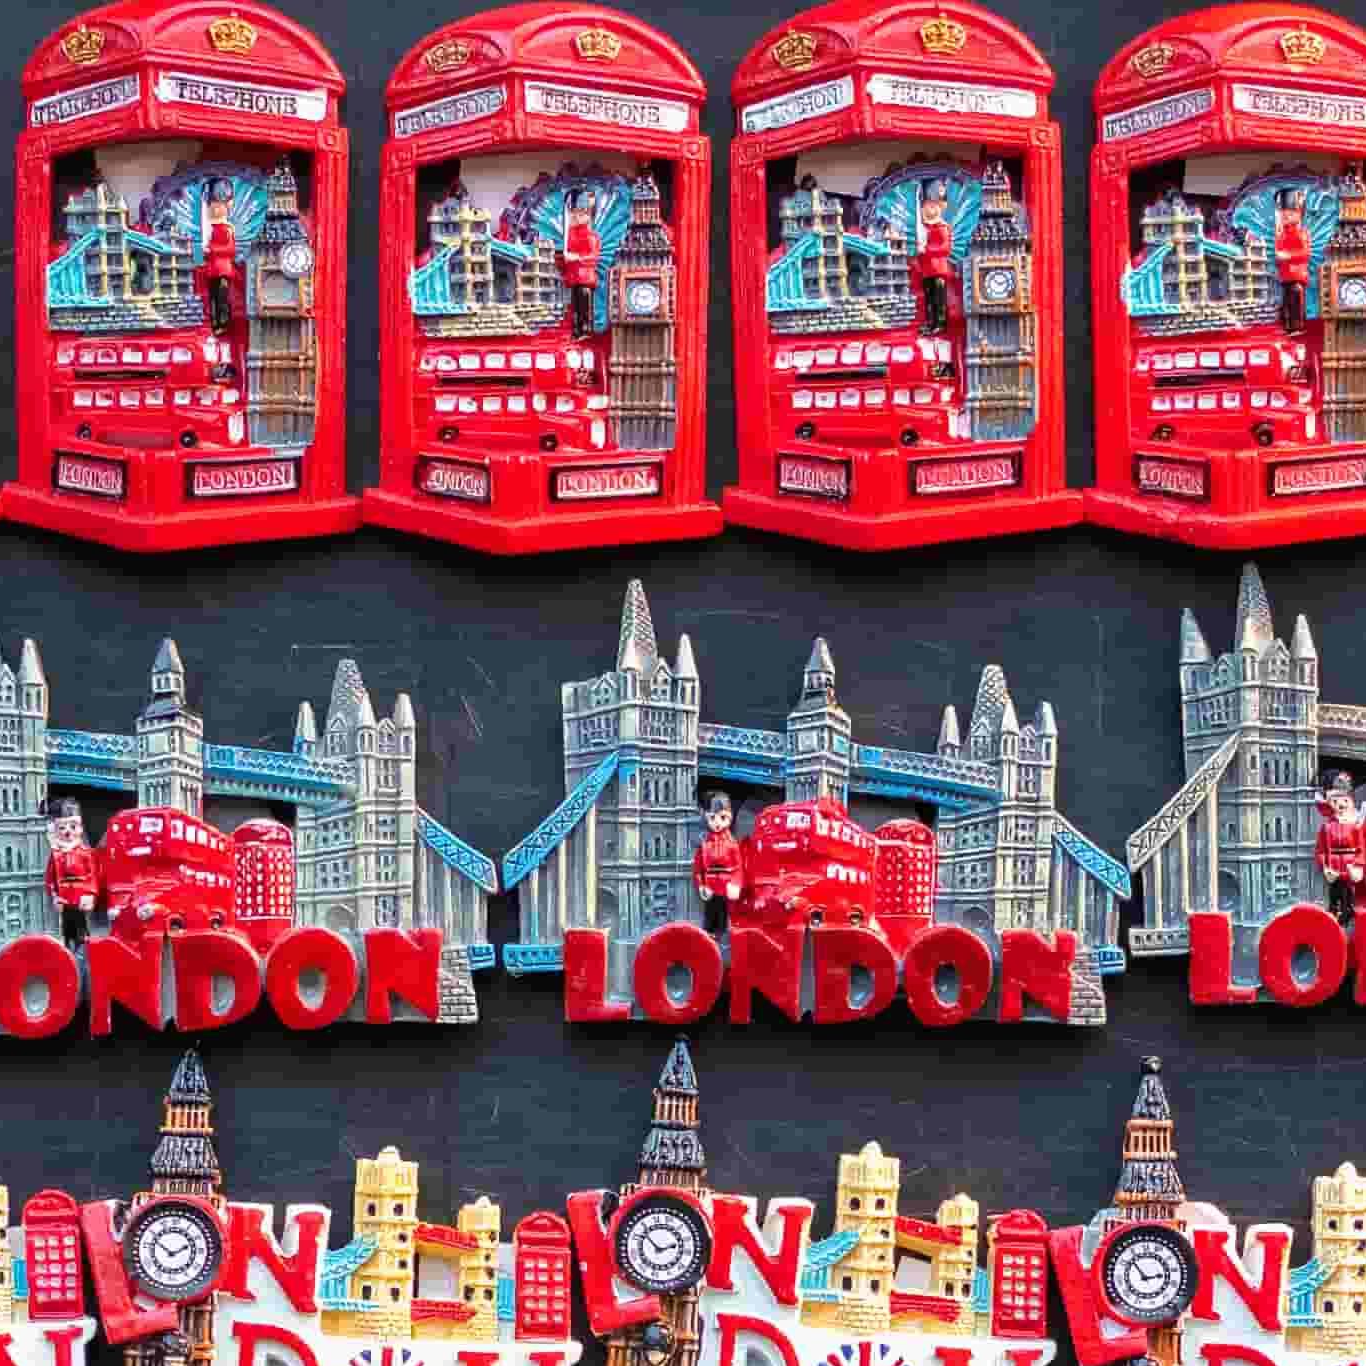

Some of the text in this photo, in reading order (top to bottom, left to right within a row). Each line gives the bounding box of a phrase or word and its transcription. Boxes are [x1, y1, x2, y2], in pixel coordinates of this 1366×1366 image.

[175, 80, 298, 115] TELEPHONE
[540, 88, 661, 124] TELEPHONE
[1247, 94, 1366, 123] TELEPHONE
[196, 461, 288, 490] LONDON
[561, 468, 649, 495] LONDON
[563, 921, 1077, 1027] LONDON
